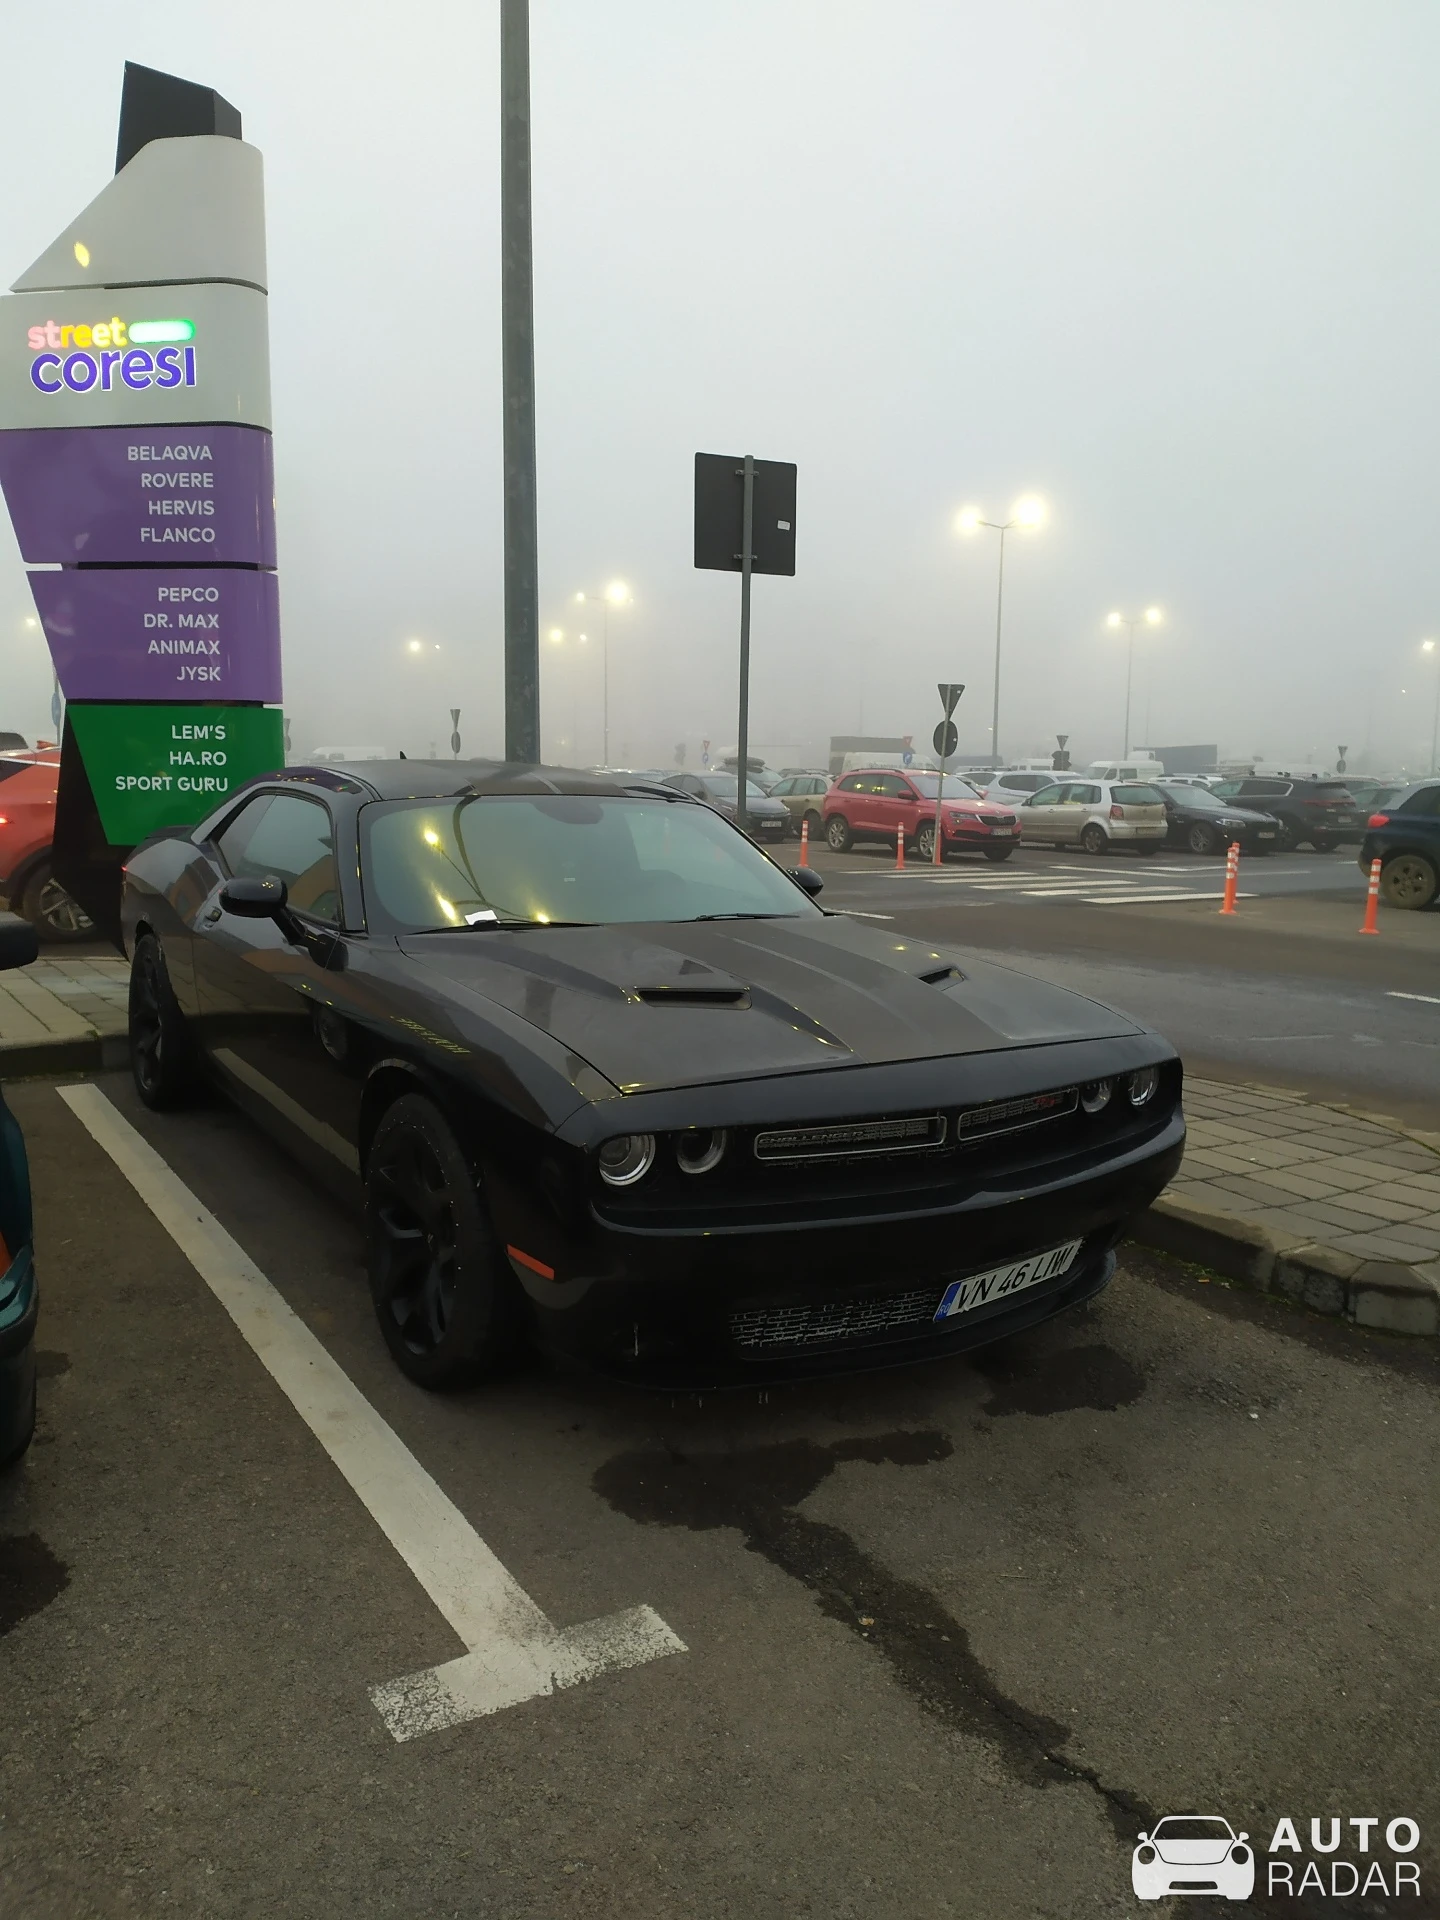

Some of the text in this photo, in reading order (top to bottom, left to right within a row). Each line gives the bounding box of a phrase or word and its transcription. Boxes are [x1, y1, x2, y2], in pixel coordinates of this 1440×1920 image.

[27, 317, 128, 350] street
[30, 347, 196, 394] coresi
[128, 445, 213, 461] BELAQVA
[141, 472, 214, 488] ROVERE
[149, 500, 215, 516] HERVIS
[140, 527, 216, 543] FLANCO
[158, 587, 220, 602] PEPCO
[144, 613, 220, 629] DR. MAX
[147, 640, 221, 655] ANIMAX
[176, 666, 222, 682] JYSK
[171, 725, 226, 741] LEM'S
[169, 751, 227, 766] HA.RO
[115, 776, 228, 792] SPORT GURU
[957, 1244, 1075, 1310] VN 46 LIW
[938, 1302, 952, 1316] RO
